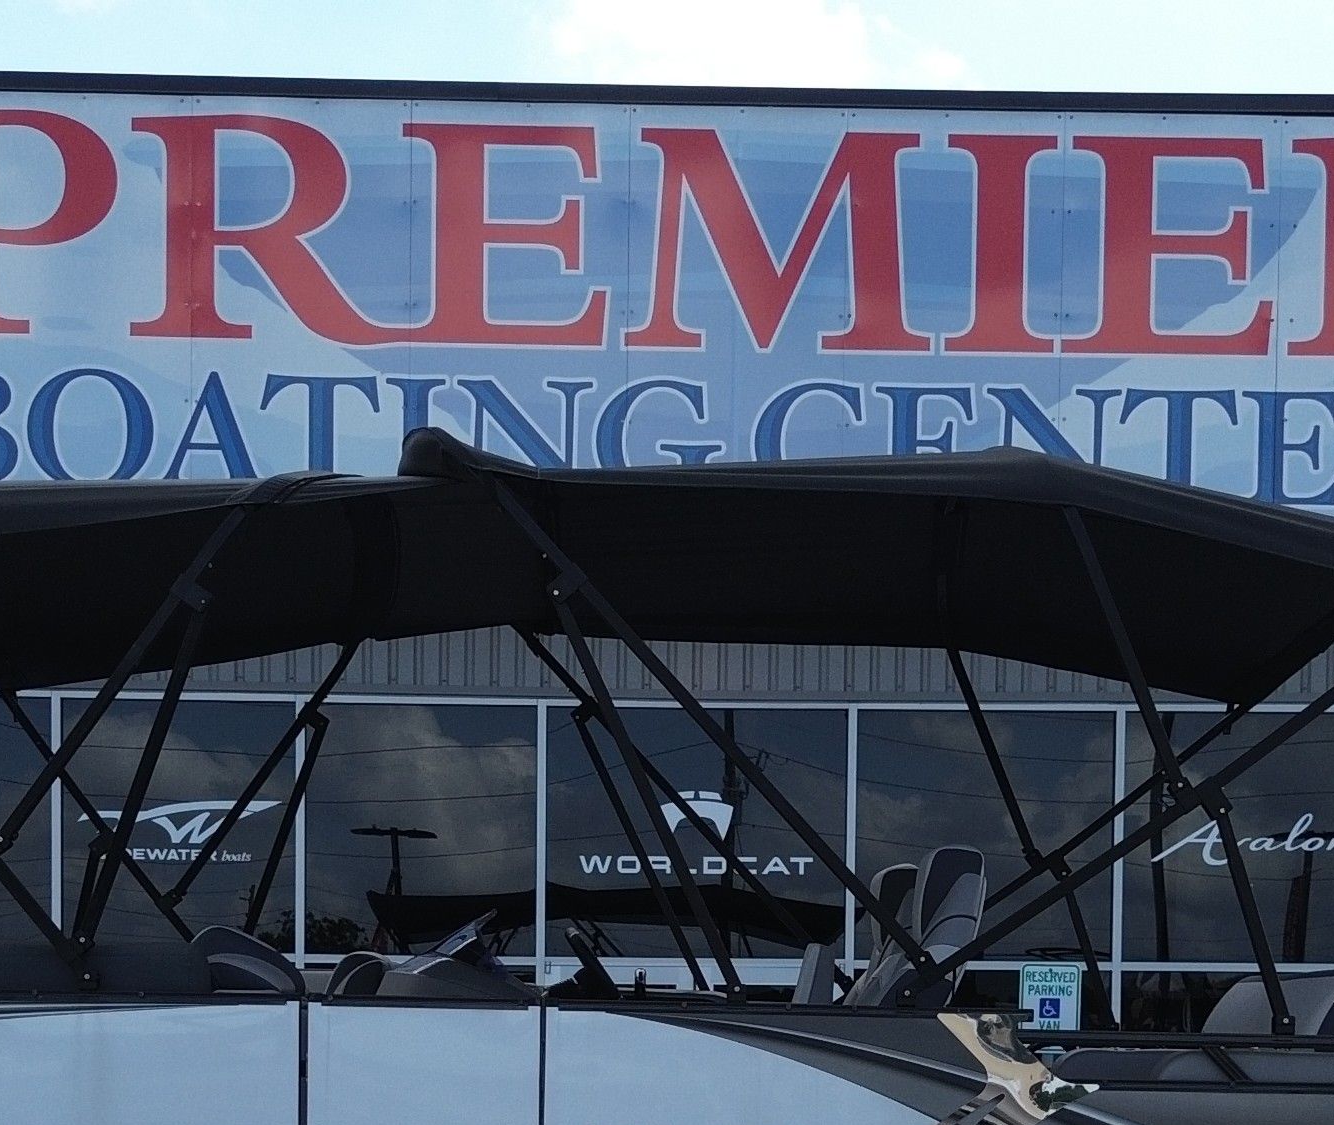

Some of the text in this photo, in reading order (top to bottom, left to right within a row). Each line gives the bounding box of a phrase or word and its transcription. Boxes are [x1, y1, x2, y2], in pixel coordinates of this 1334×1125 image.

[100, 847, 253, 863] EWATE boats
[579, 854, 814, 876] WORDAT
[1025, 970, 1076, 983] RESERVED
[1028, 984, 1073, 997] PARKING
[1039, 1020, 1060, 1031] VAN
